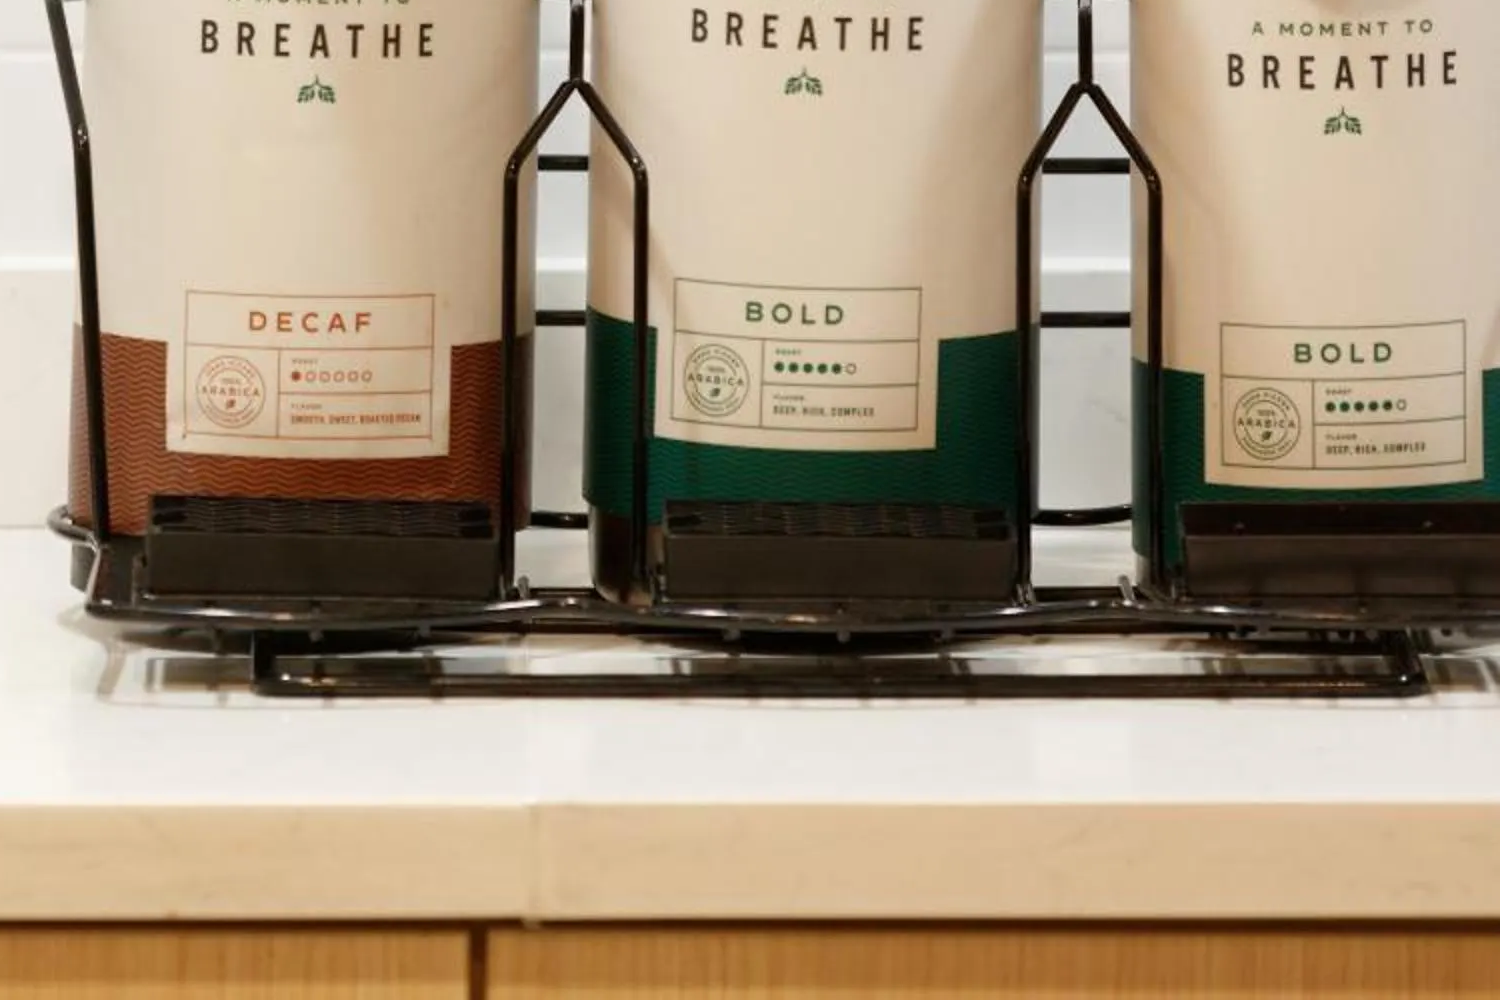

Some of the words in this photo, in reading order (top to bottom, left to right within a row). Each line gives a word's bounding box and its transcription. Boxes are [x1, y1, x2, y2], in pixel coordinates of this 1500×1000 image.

[201, 19, 434, 58] BREATHE
[691, 8, 924, 51] BREATHE
[1251, 21, 1264, 36] A
[1278, 21, 1389, 37] MOMENT
[1404, 19, 1433, 34] TO
[1226, 49, 1457, 90] BREATHE
[249, 311, 372, 333] DECAF
[745, 301, 844, 325] BOLD
[1293, 342, 1393, 364] BOLD
